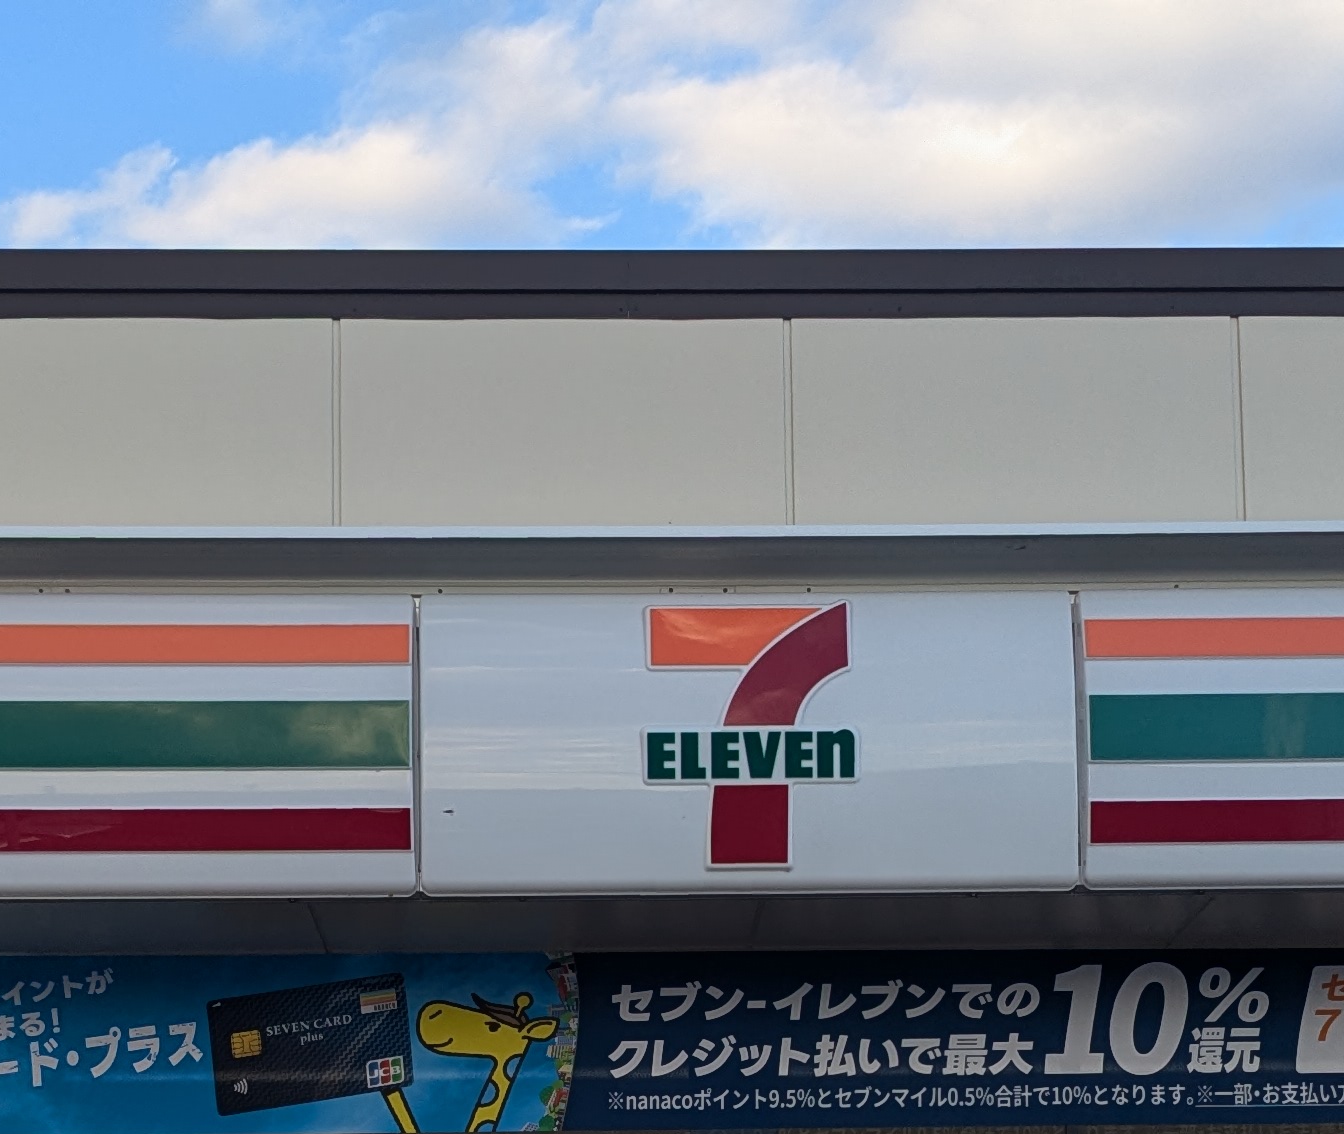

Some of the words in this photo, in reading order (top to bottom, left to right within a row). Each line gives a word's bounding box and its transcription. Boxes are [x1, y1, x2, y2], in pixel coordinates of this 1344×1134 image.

[266, 1021, 310, 1037] SEVEN
[313, 1014, 353, 1030] CARD
[300, 1032, 324, 1046] plus
[607, 1032, 1035, 1078] クレジット払いで最大
[1187, 1027, 1261, 1074] 還元
